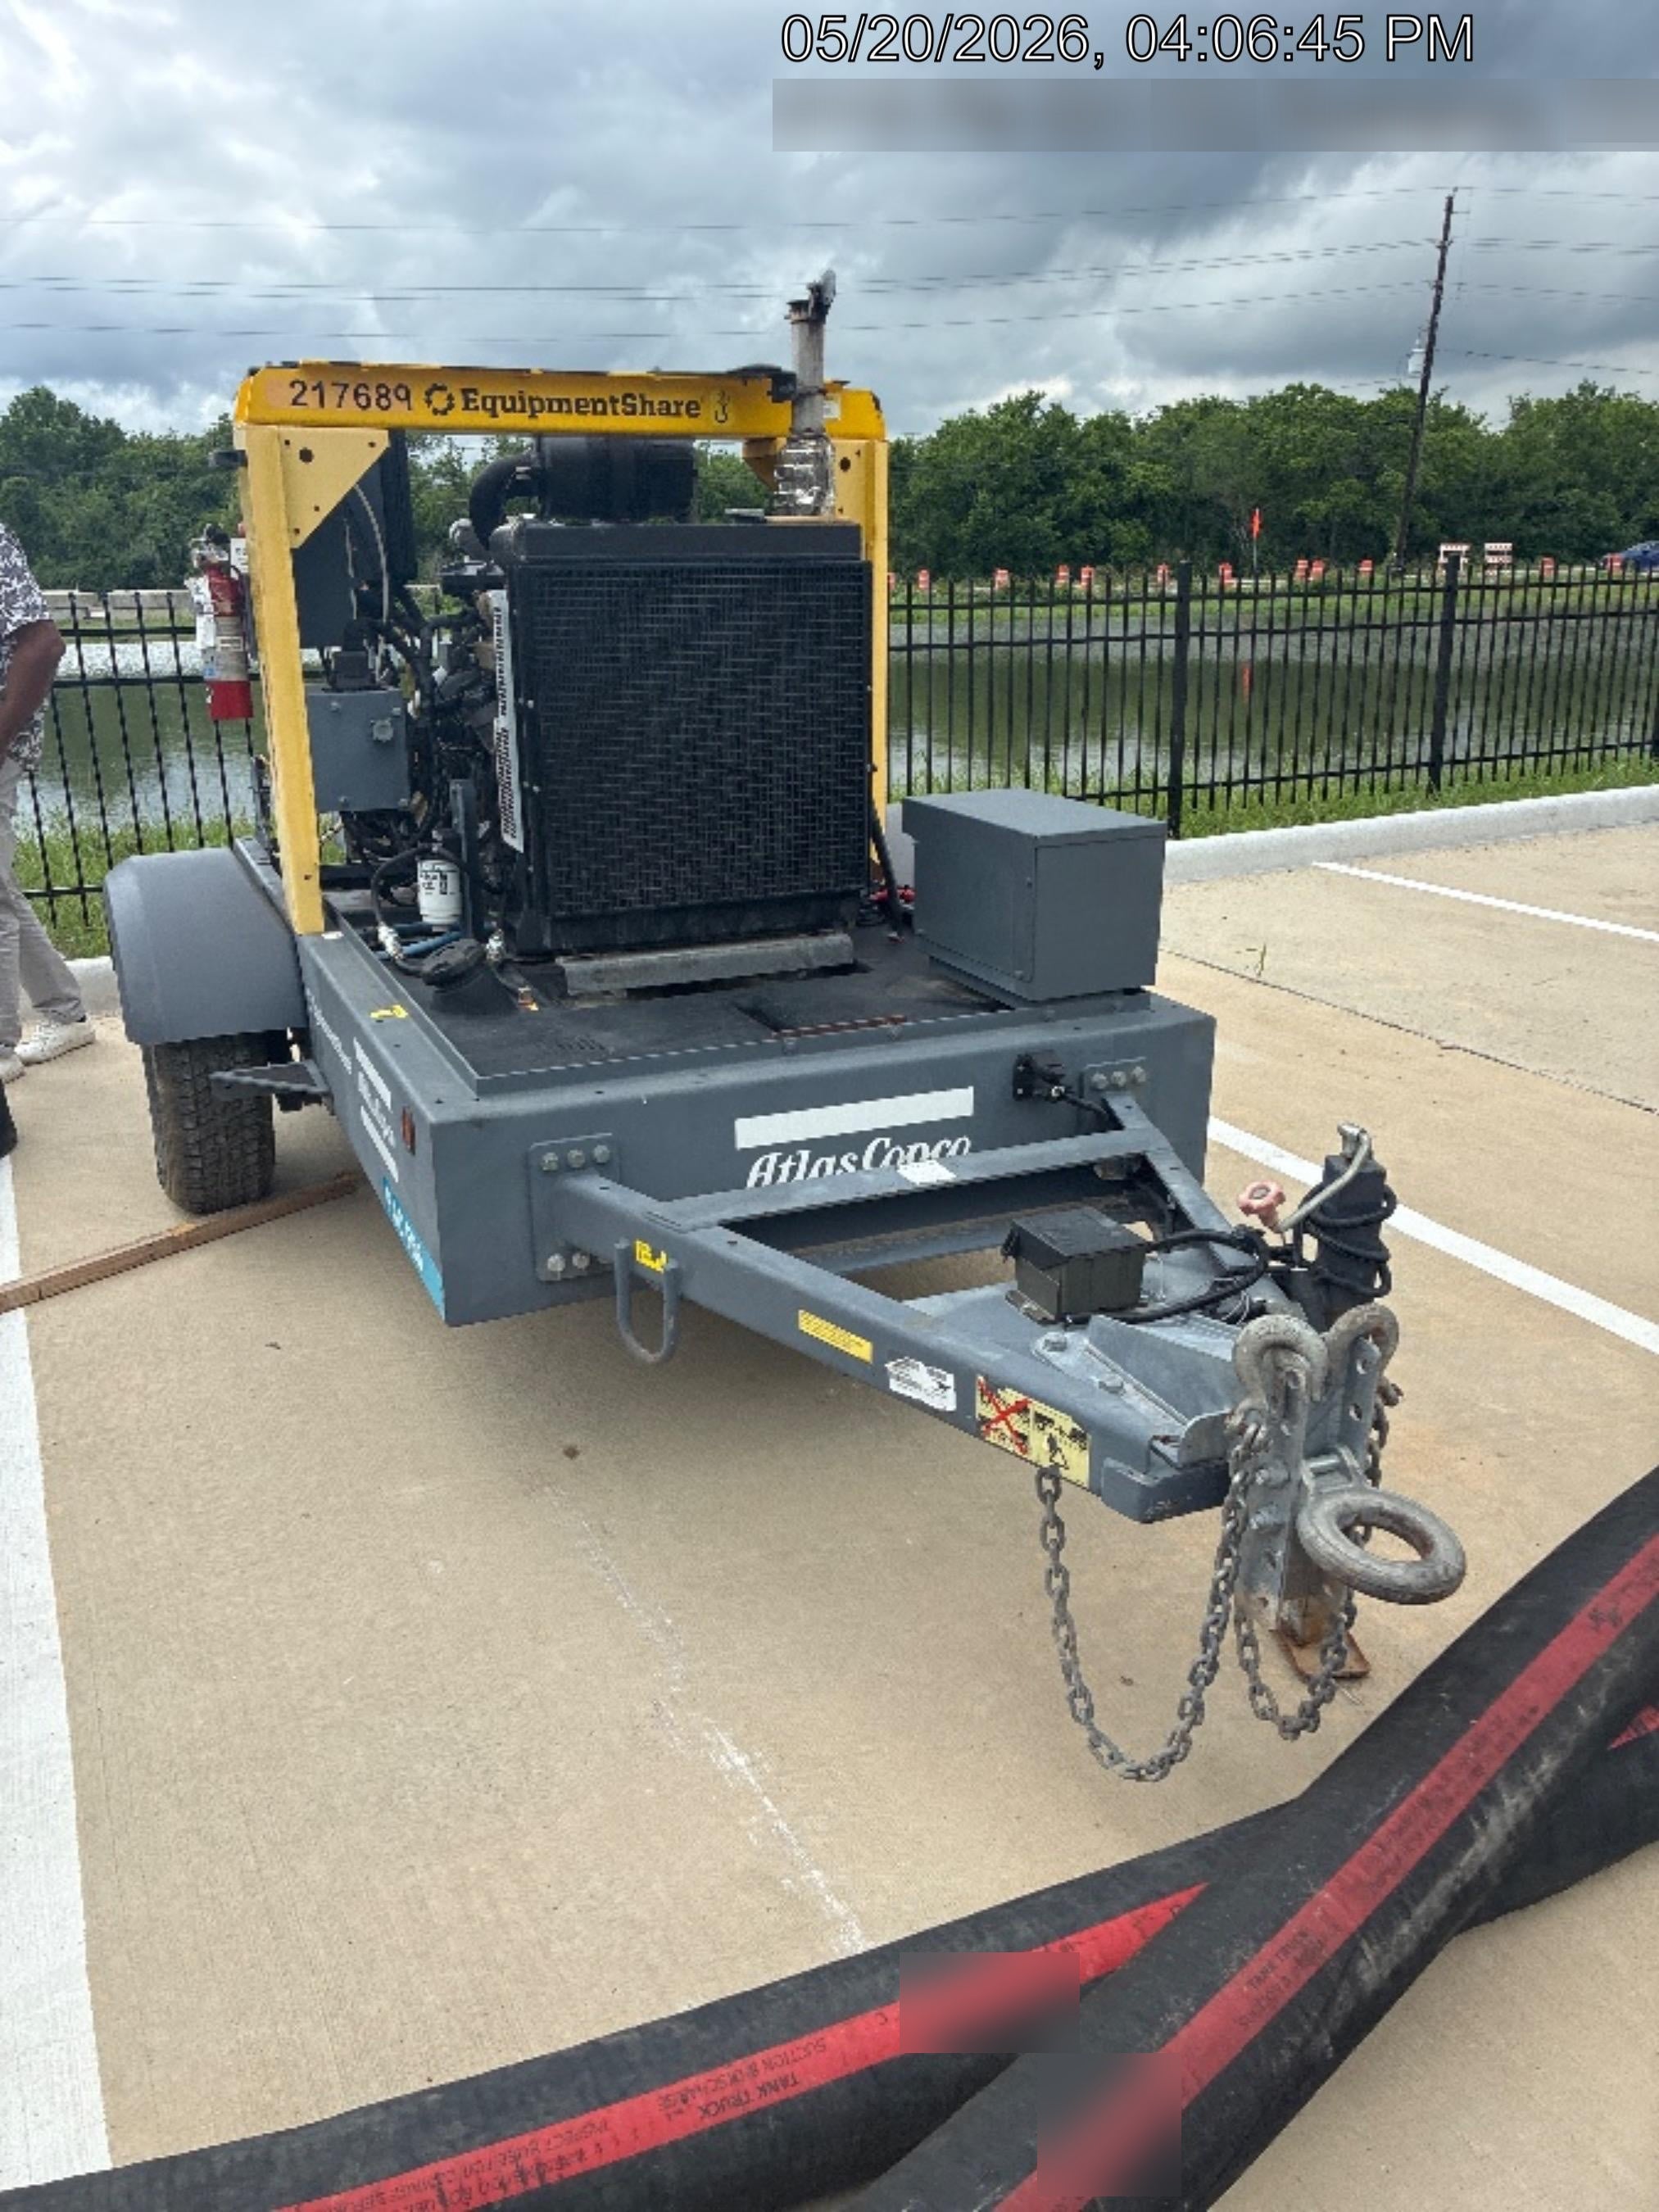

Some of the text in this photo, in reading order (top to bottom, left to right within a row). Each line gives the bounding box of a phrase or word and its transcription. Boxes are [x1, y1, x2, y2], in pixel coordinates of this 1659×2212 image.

[289, 378, 701, 419] 217689 EquipmentShare
[746, 1149, 859, 1189] Atlas
